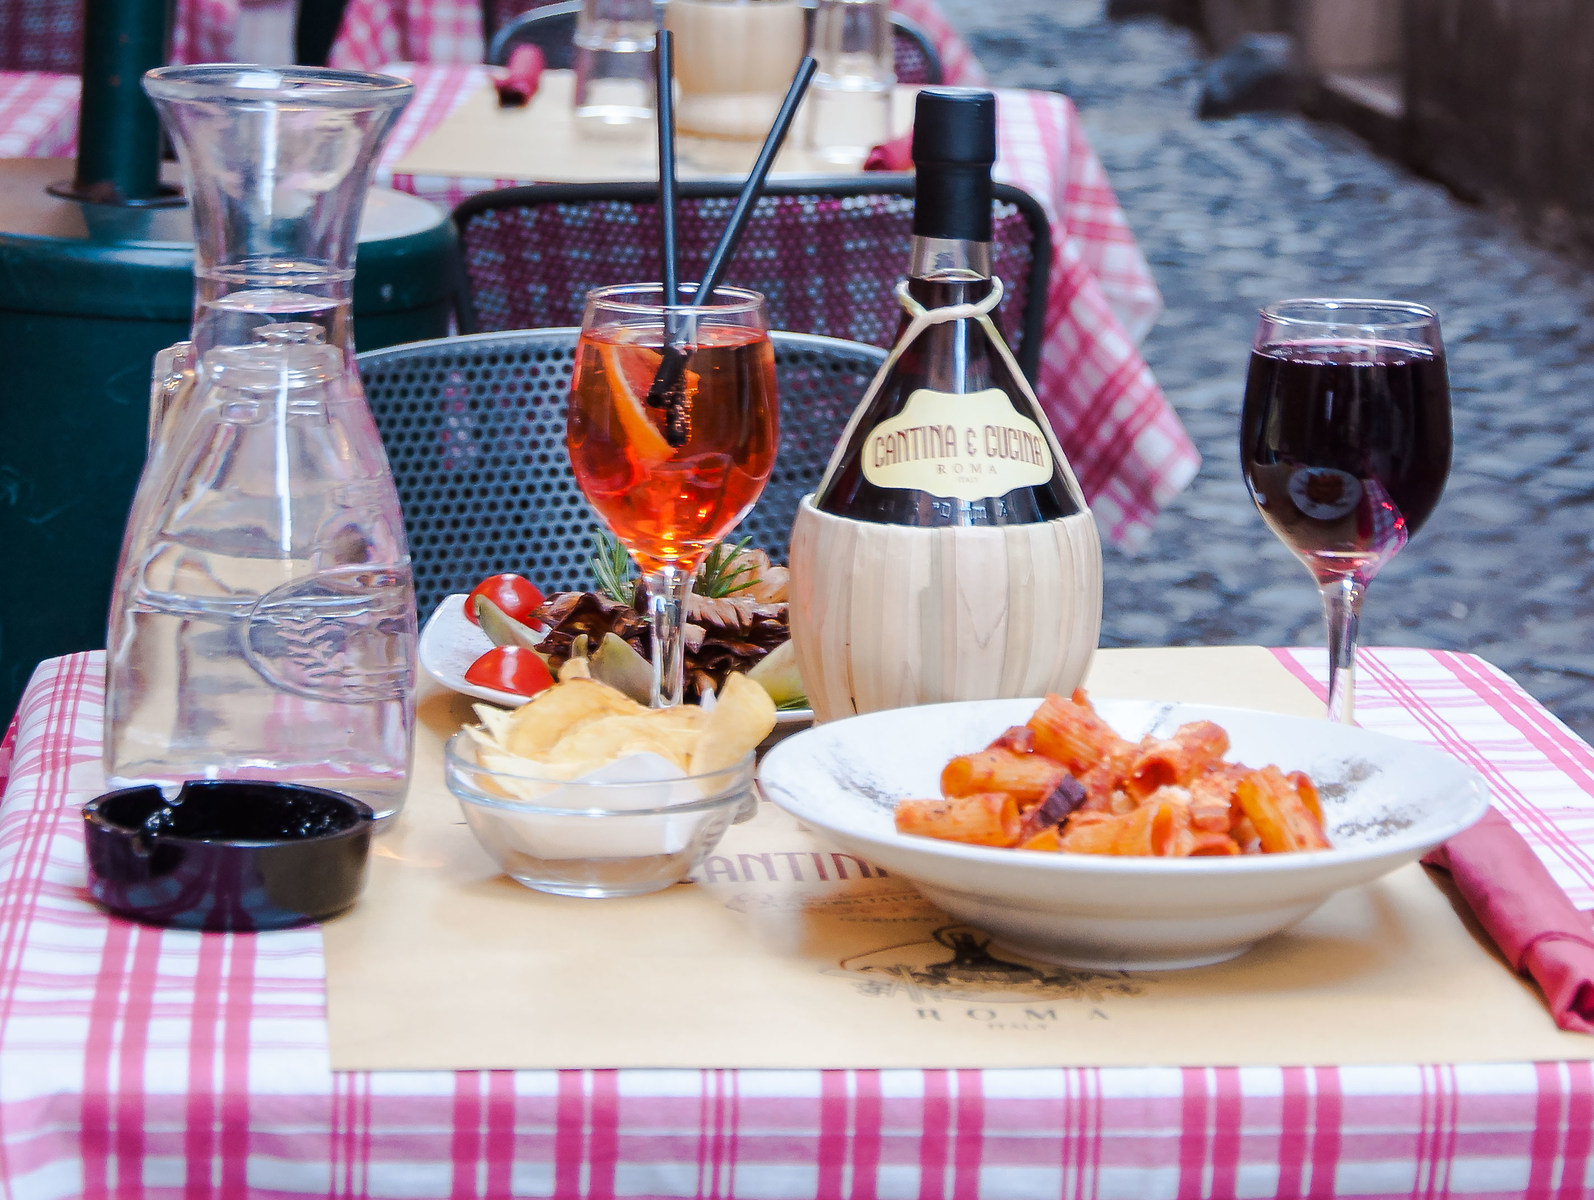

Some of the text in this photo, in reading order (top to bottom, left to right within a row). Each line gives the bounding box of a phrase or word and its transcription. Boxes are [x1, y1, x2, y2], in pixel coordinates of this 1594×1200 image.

[874, 424, 958, 468] CANTINA
[984, 424, 1045, 468] CUCINA
[936, 463, 998, 475] ROMA
[684, 852, 889, 884] ANTIN
[915, 1007, 1110, 1022] ROMA
